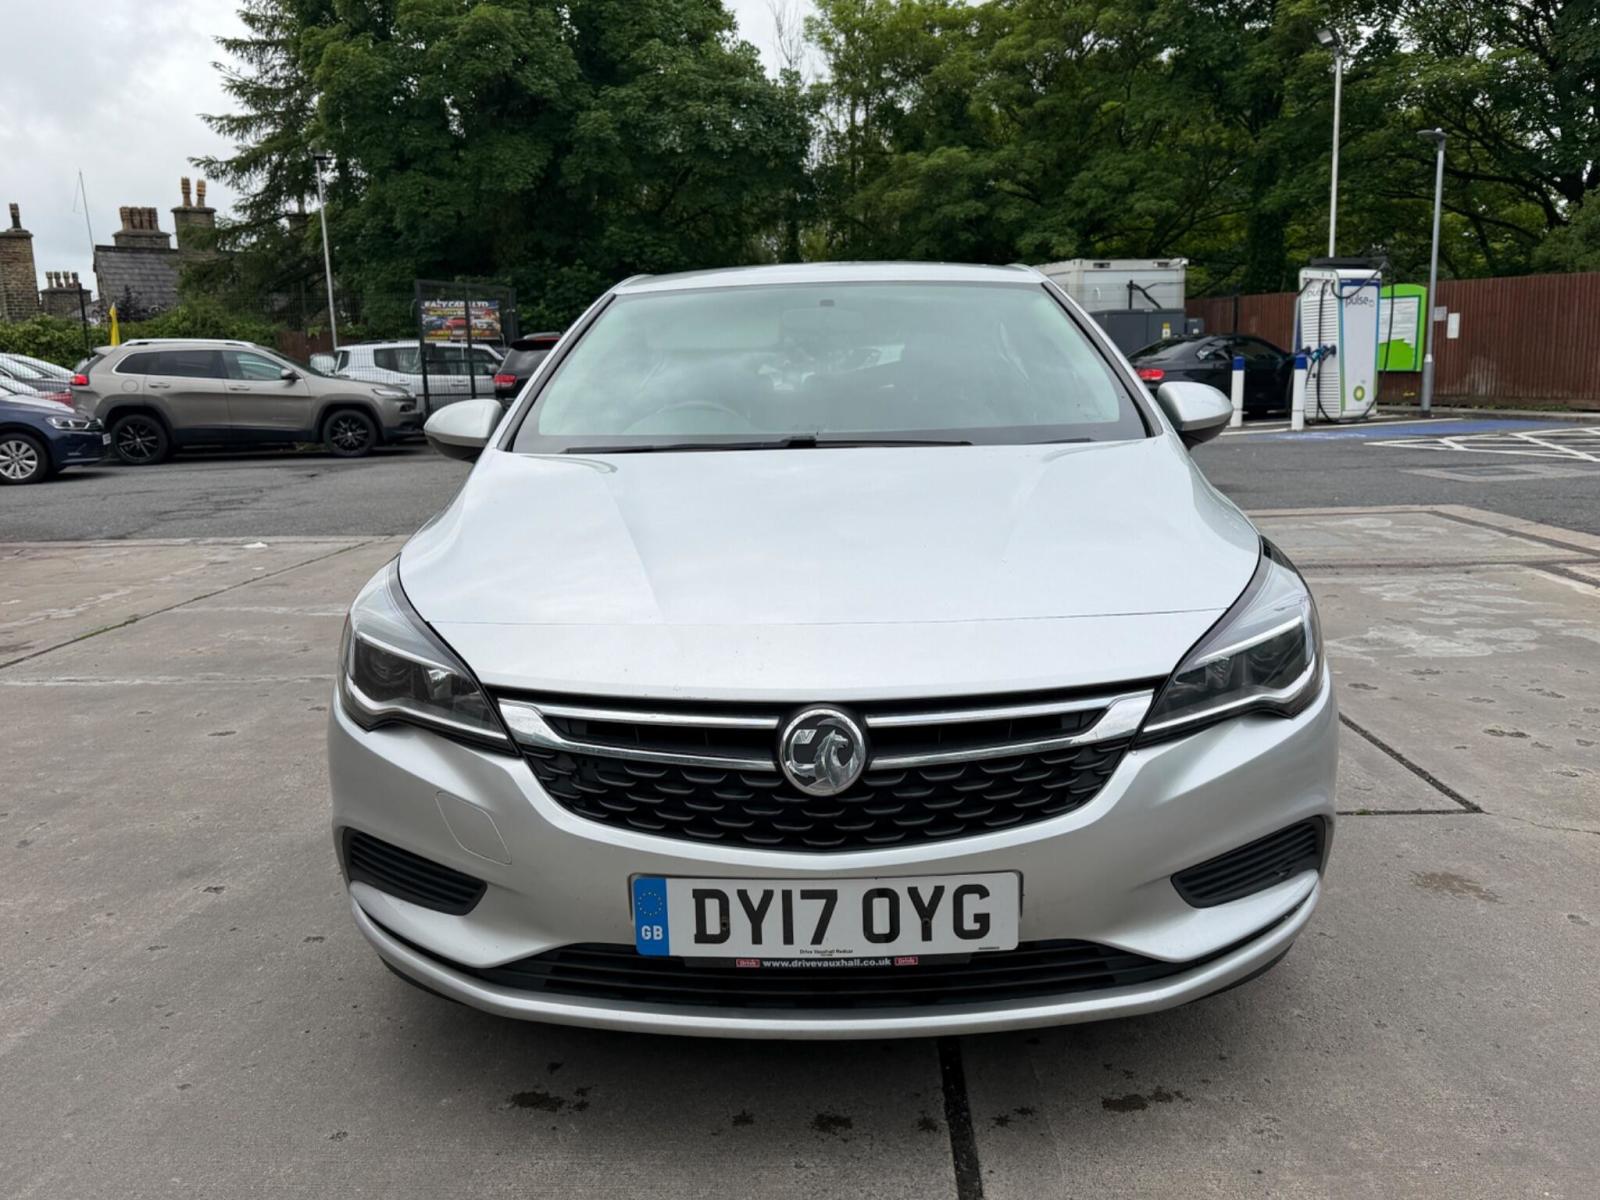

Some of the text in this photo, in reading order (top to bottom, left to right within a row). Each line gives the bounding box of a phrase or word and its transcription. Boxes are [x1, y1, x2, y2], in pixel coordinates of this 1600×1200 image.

[472, 300, 489, 308] LTD
[1345, 293, 1369, 308] pulse
[691, 884, 991, 946] DY17 OYG
[641, 925, 664, 941] GB
[762, 957, 892, 968] www.drivevauxhall.co.uk
